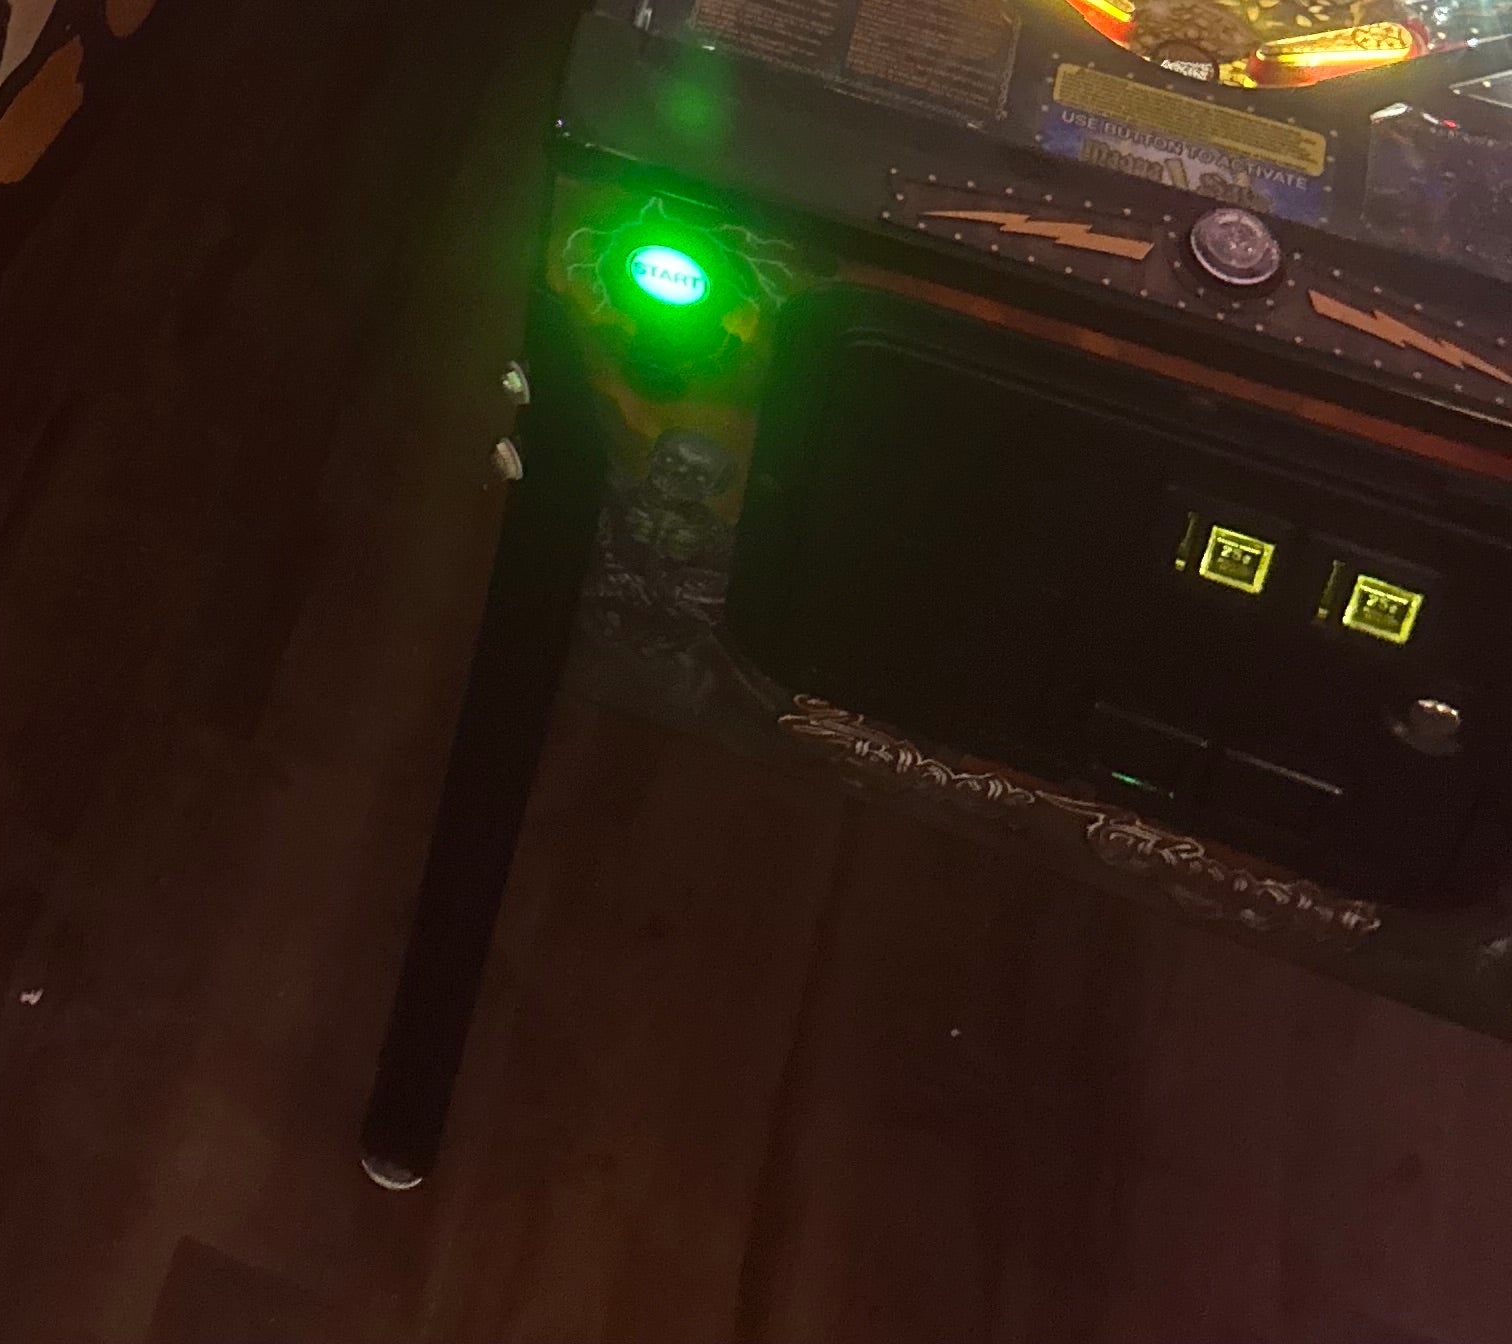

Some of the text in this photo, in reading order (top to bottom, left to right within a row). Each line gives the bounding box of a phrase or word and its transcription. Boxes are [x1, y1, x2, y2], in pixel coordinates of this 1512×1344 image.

[1061, 110, 1104, 131] USE
[1104, 121, 1185, 154] BUTTON
[1187, 144, 1216, 163] TO
[1215, 154, 1309, 191] ACTIVATE
[634, 261, 704, 289] START
